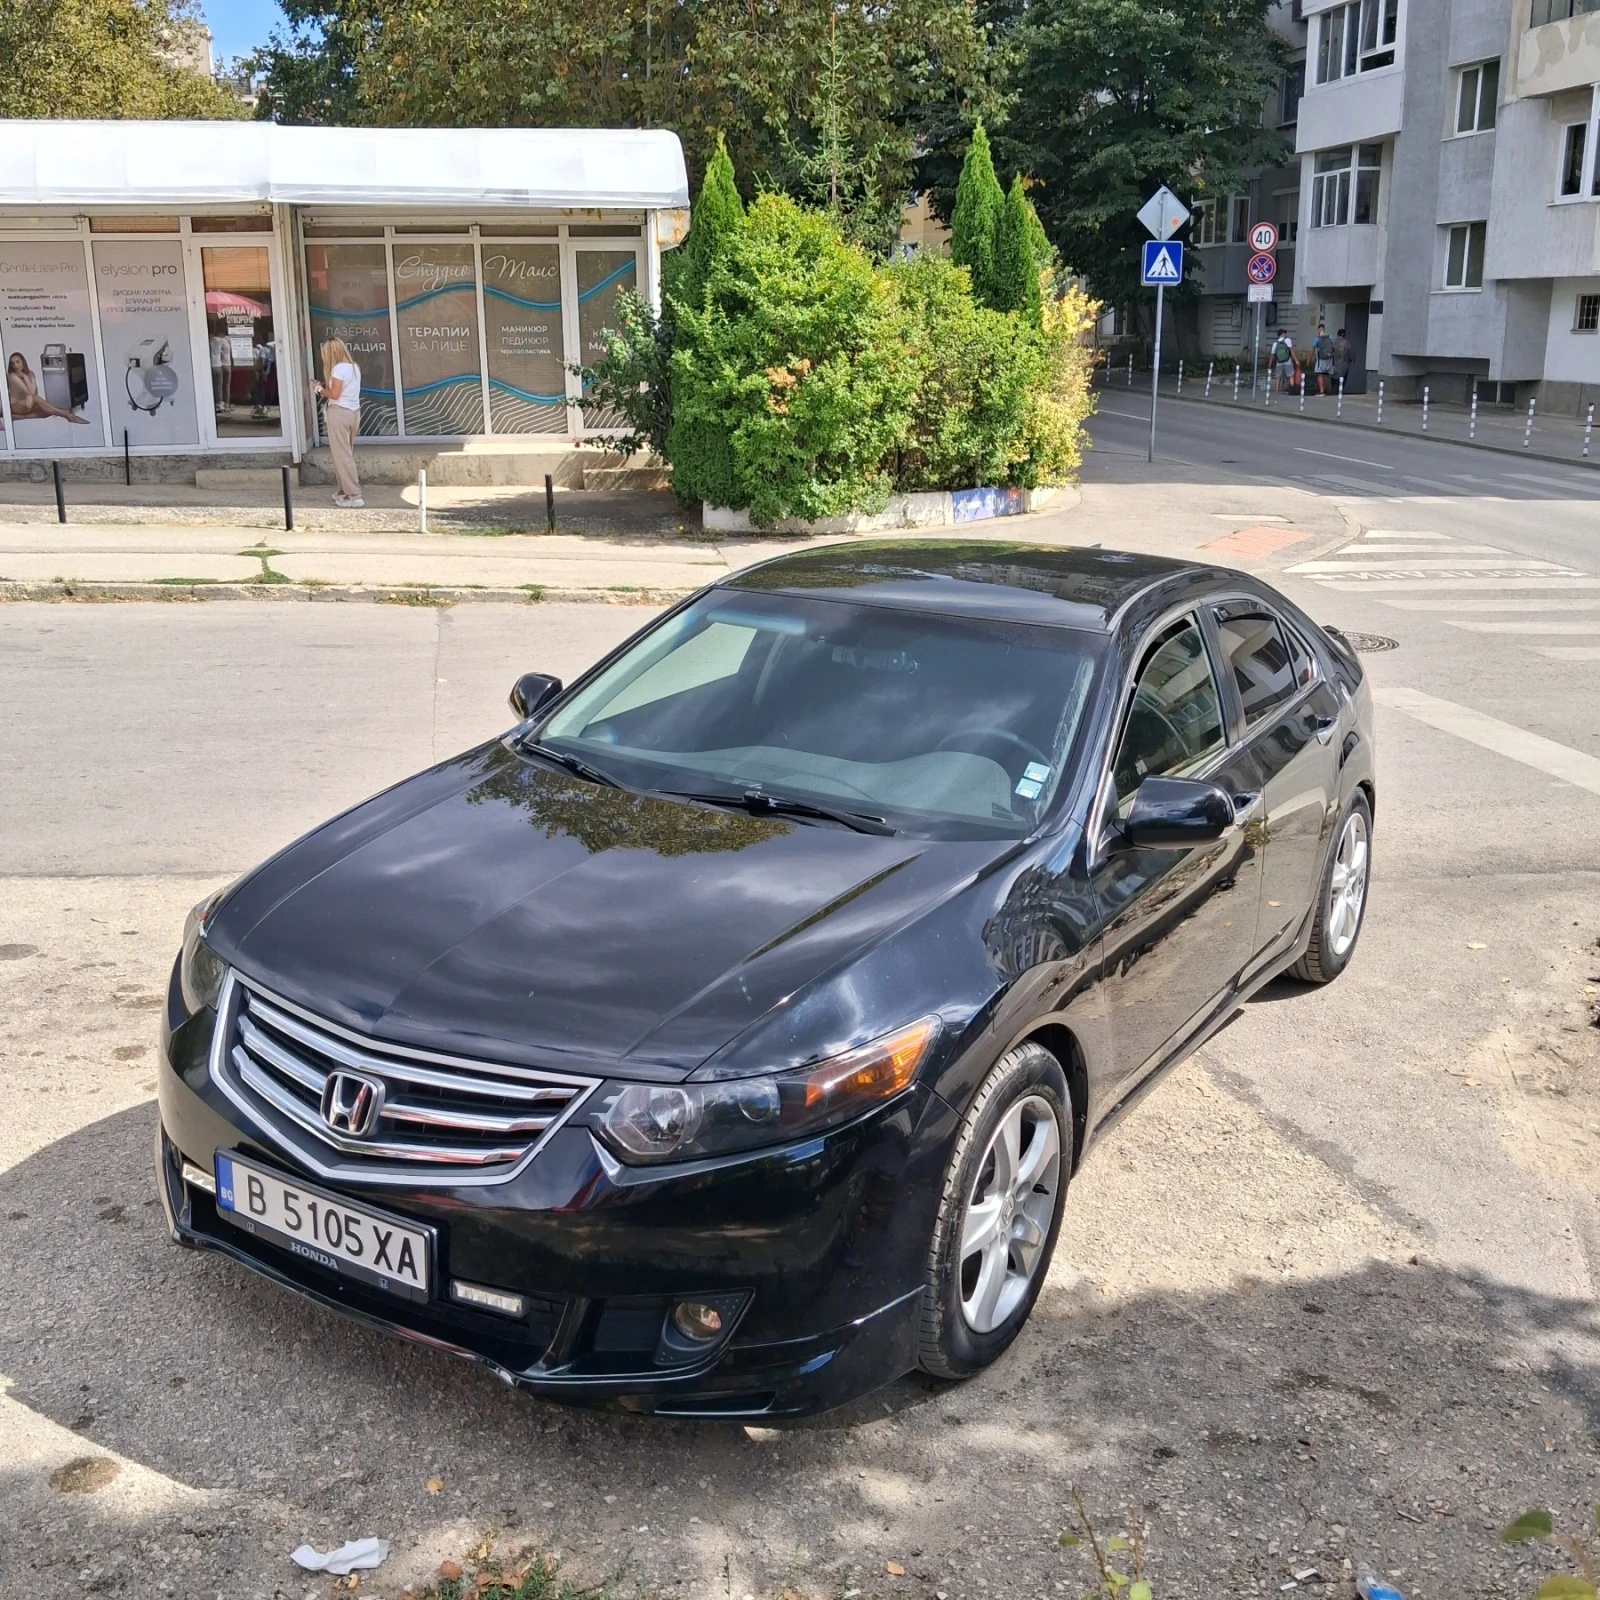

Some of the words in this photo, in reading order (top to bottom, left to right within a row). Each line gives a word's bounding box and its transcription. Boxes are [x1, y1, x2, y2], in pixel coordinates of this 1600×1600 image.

[1255, 230, 1272, 244] 40
[60, 262, 79, 273] Pro
[101, 263, 149, 278] elysion
[152, 265, 178, 278] pro
[396, 255, 471, 292] Студио
[217, 305, 263, 319] КЛИМАТИК
[226, 315, 255, 324] ОТВОРЕНО
[325, 326, 380, 337] ЛАЗЕРНА
[407, 326, 470, 337] ТЕРАПИИ
[501, 325, 548, 333] МАНИКЮР
[411, 340, 428, 352] ЗА
[430, 340, 468, 353] ЛИЦЕ
[502, 337, 549, 346] ПЕДИКЮР
[220, 1187, 234, 1202] BG
[247, 1173, 267, 1216] B
[283, 1189, 364, 1257] 5105
[373, 1225, 419, 1281] XA
[290, 1241, 339, 1270] HONDA
